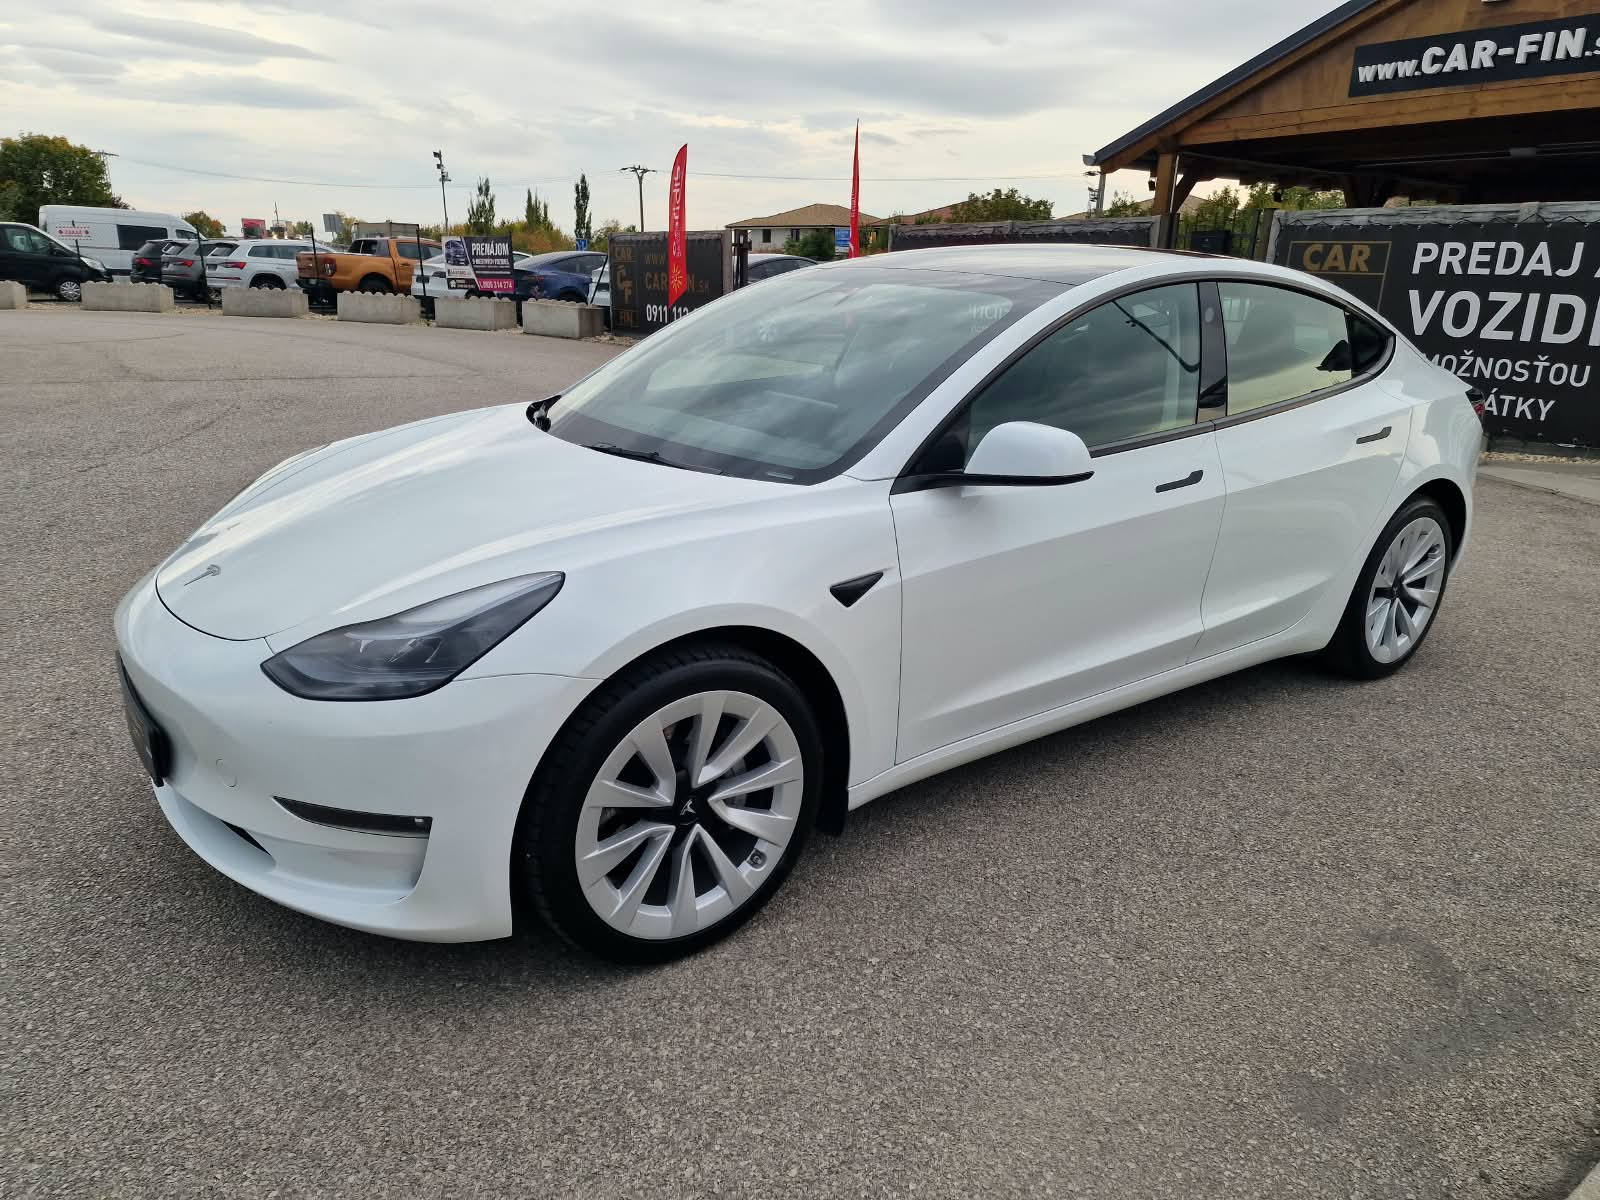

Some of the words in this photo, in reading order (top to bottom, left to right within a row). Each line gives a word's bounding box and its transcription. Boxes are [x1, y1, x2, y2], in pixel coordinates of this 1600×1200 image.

[471, 240, 509, 256] PRENÁJOM
[1302, 244, 1371, 272] CAR
[1411, 241, 1585, 277] PREDAJ
[646, 303, 668, 323] 0911
[1484, 388, 1556, 421] ÁTKY
